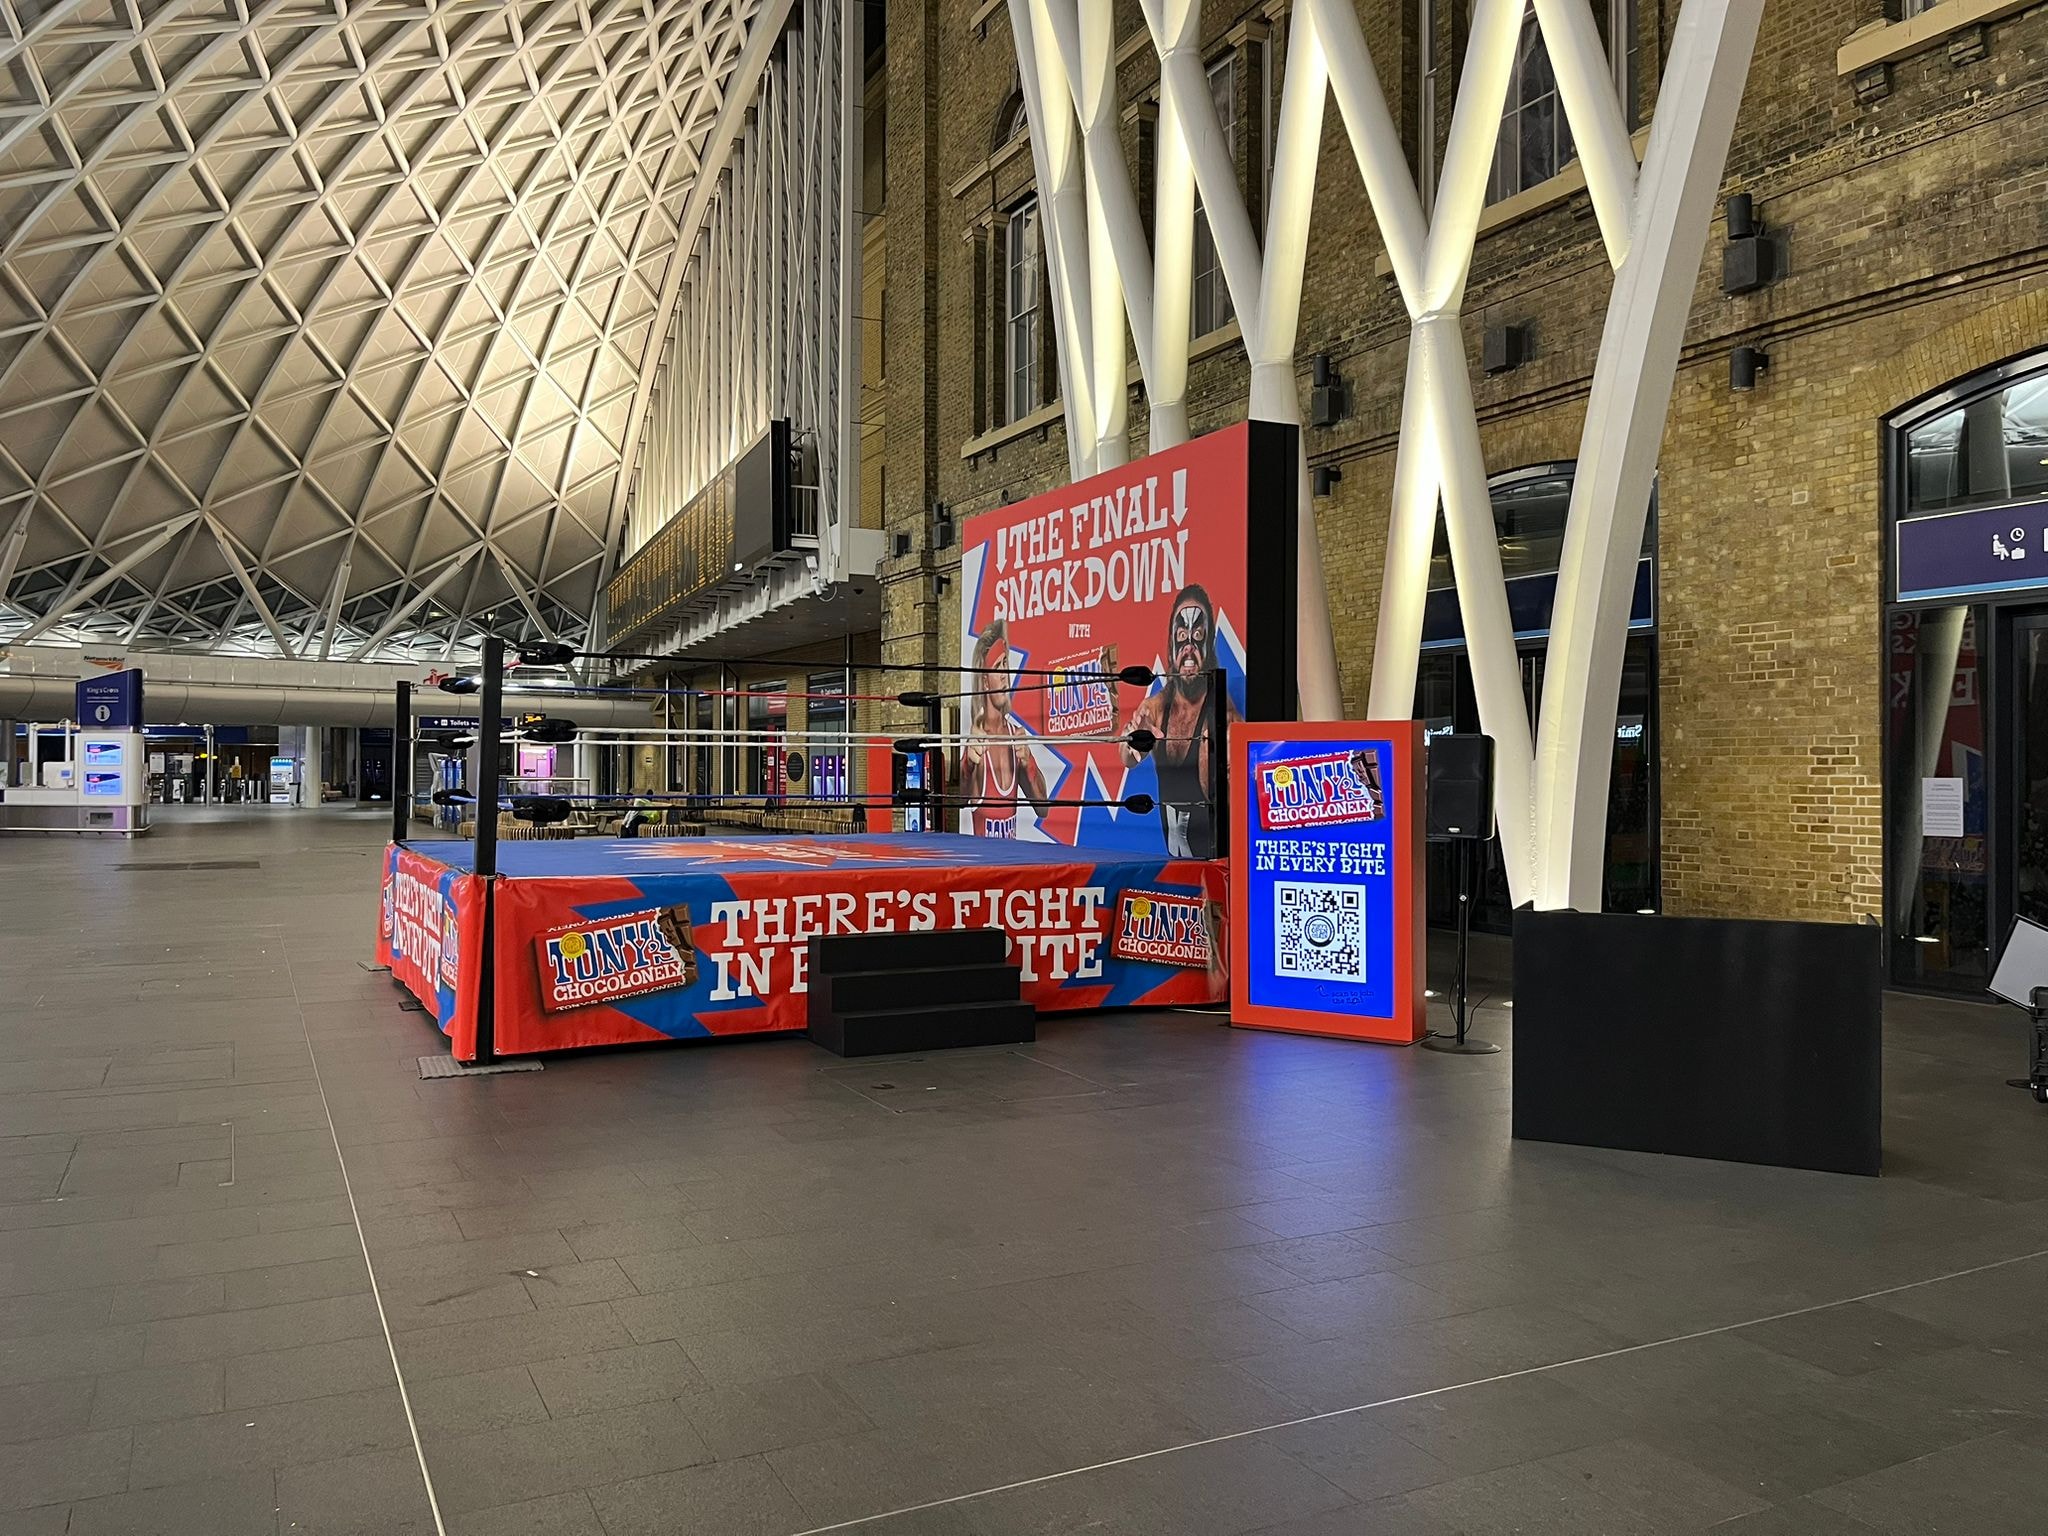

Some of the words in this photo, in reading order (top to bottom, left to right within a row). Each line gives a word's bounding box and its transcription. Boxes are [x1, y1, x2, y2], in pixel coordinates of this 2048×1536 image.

[1009, 509, 1063, 569] THE
[1070, 476, 1168, 550] FINAL
[994, 529, 1188, 621] SNACKDOWN
[1069, 624, 1091, 638] WITH
[1048, 706, 1112, 733] CHOCOLONELY
[1263, 759, 1364, 809] TONY'S
[1268, 800, 1372, 823] CHOCOLONELY
[1255, 840, 1326, 856] THERE'S
[1328, 842, 1386, 859] FIGHT
[1256, 855, 1275, 871] IN
[1279, 856, 1336, 873] EVERY
[1340, 858, 1386, 875] BITE
[710, 889, 937, 947] THERE'S
[949, 887, 1105, 930] FIGHT
[545, 920, 676, 985] TONY'S
[710, 947, 775, 1001] IN
[1006, 932, 1103, 982] ITE
[553, 962, 683, 1002] CHOCOLONELY
